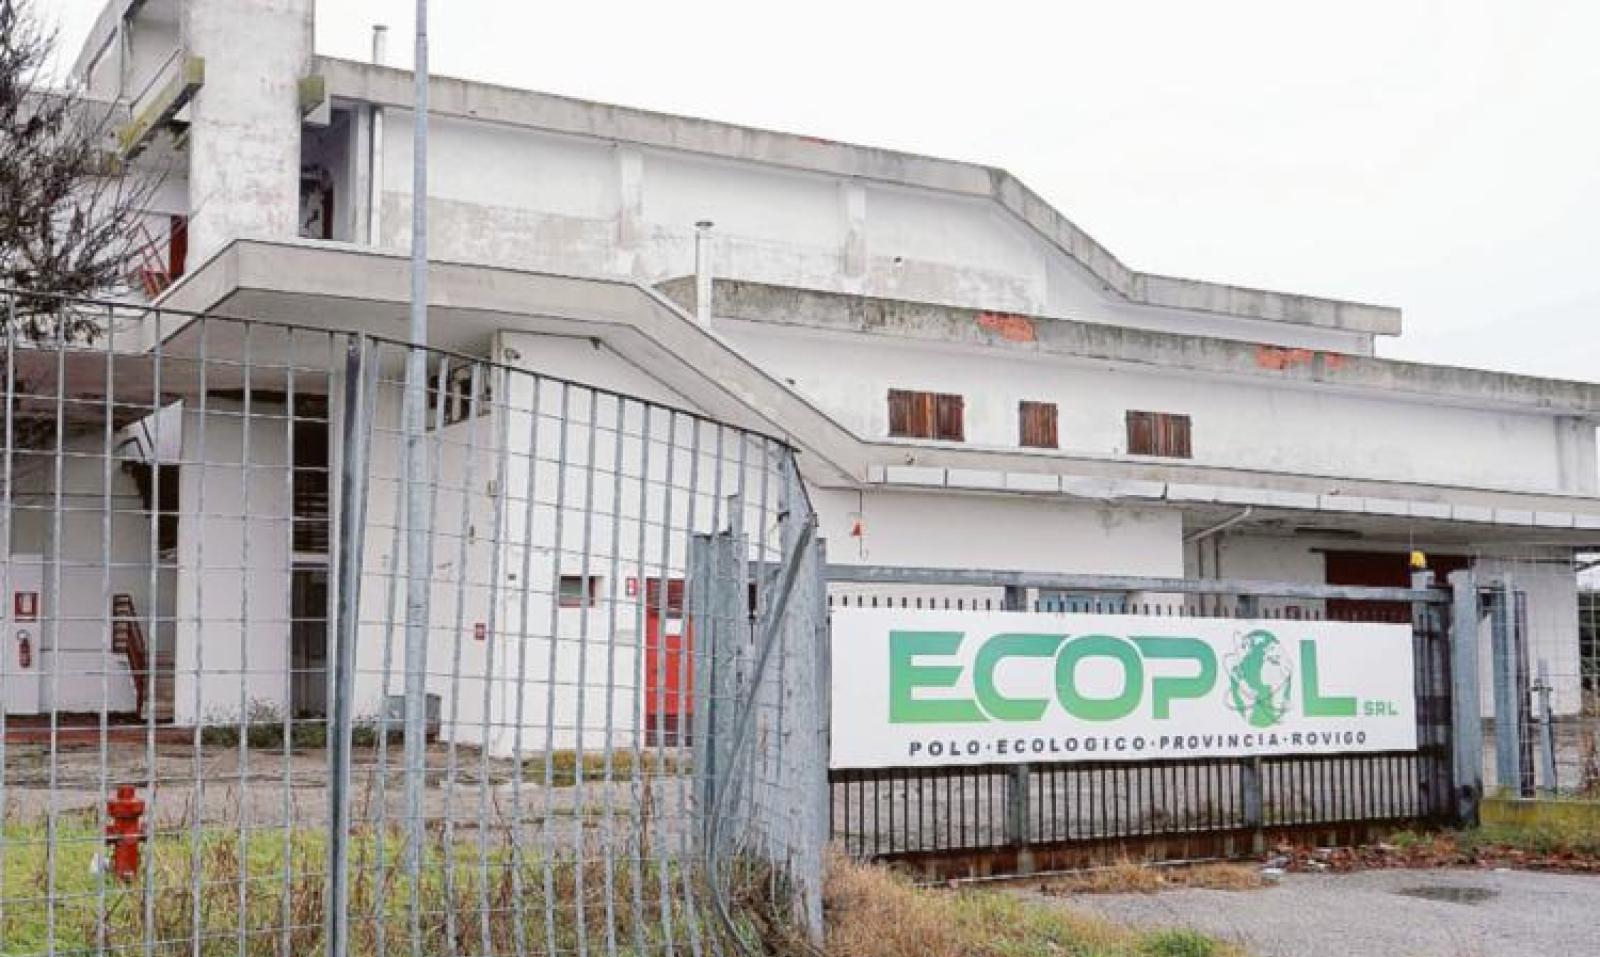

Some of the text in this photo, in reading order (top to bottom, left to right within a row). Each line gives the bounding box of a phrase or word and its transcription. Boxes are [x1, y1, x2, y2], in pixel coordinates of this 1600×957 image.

[1363, 700, 1400, 717] SRL
[908, 740, 980, 756] POLO
[1159, 733, 1279, 751] PROVINCIA
[1292, 730, 1366, 746] ROVIGO
